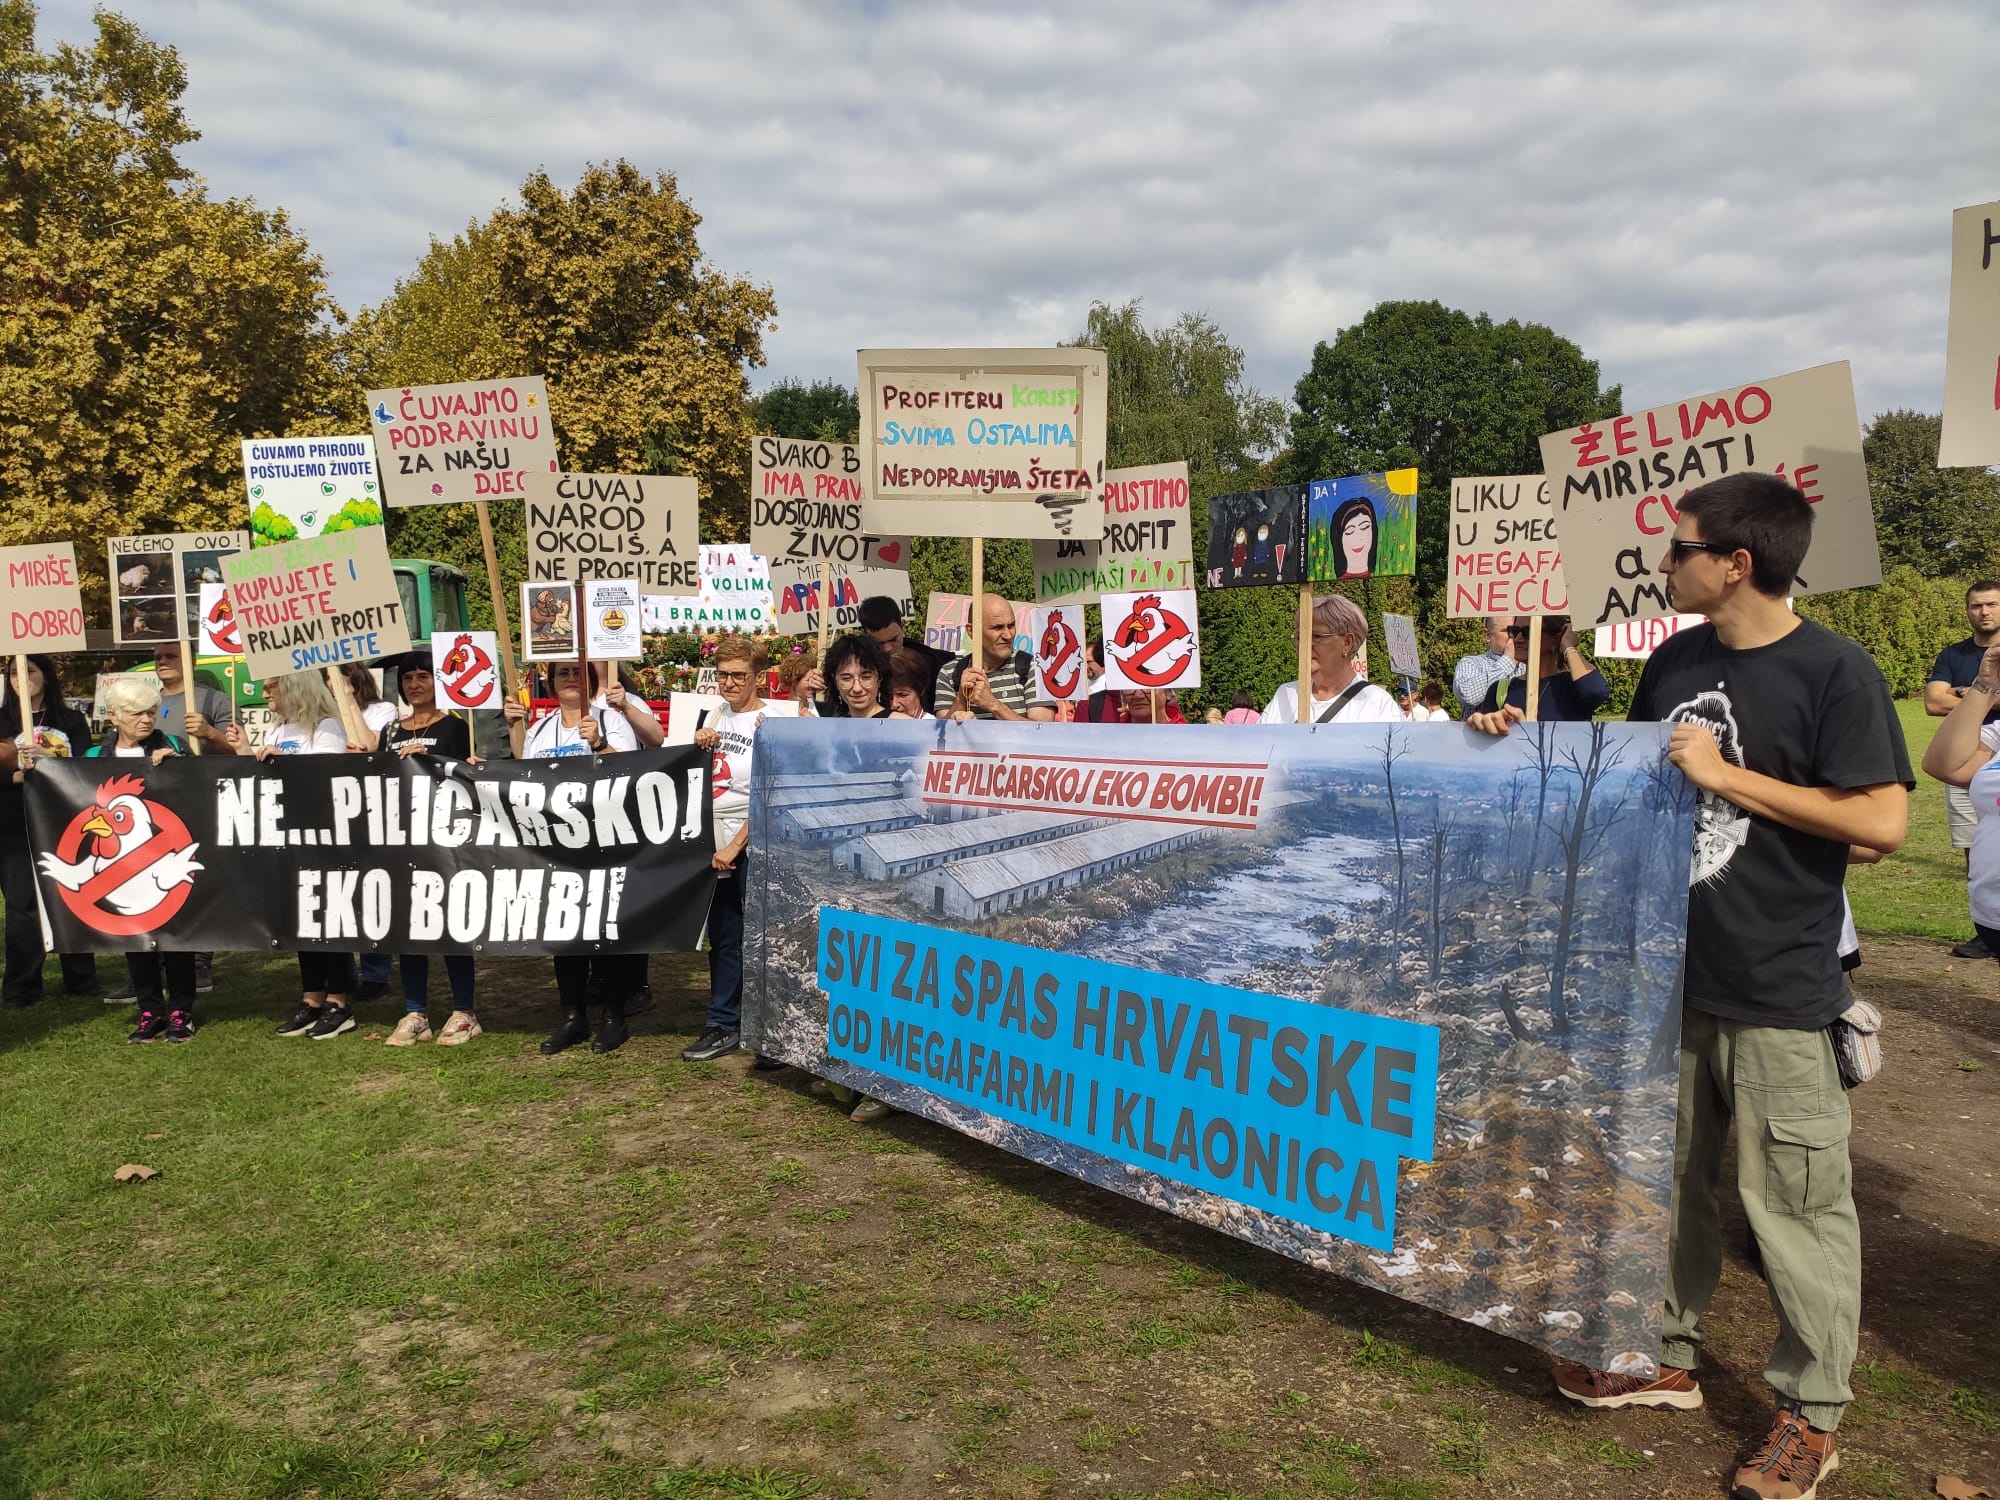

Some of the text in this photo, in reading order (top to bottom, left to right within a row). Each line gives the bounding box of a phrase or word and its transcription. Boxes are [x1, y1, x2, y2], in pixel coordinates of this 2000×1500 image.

[400, 388, 518, 421] ČUVAJMO
[883, 385, 1002, 410] PROFITERU
[389, 416, 539, 449] PODRAVINU
[883, 418, 1074, 447] SVIMA OSTALIMA
[1571, 386, 1772, 468] ŽELIMO
[252, 443, 365, 460] ČUVAMO PRIRODU
[399, 441, 510, 474] ZA NAŠU
[759, 438, 860, 472] SVAKO B
[251, 460, 372, 479] POŠTUJEMO ŽIVOTE
[474, 471, 526, 495] DJEC
[1563, 433, 1754, 511] MIRISATI
[557, 475, 644, 503] ČUVAJ
[764, 472, 861, 501] IMA PRAV
[1104, 478, 1189, 514] PUSTIMO
[1456, 481, 1549, 513] LIKU G
[531, 503, 671, 532] NAROD I
[754, 498, 862, 531] DOSTOJANS
[112, 537, 174, 553] NEĆEMO
[659, 538, 676, 556] A
[787, 527, 880, 561] ŽIVOT
[1099, 520, 1176, 556] PROFIT
[1456, 522, 1477, 546] U
[9, 554, 74, 588] MIRIŠE
[233, 559, 357, 606] KUPUJETE I
[535, 558, 565, 580] NE
[579, 558, 697, 587] PROFITERE
[1041, 557, 1191, 597] NADMAŠI ŽIVOT
[1207, 568, 1224, 588] NE
[238, 591, 337, 628] TRUJETE
[781, 577, 859, 614] APAJA
[11, 607, 82, 639] DOBRO
[247, 603, 399, 654] PRLJAVI PROFIT
[654, 607, 761, 620] I BRANIMO
[291, 632, 381, 670] SNUJETE
[924, 755, 1264, 817] NE PILIĆARSKOJ EKO BOMBI!
[298, 866, 627, 942] EKO BOMBI!
[825, 926, 1417, 1139] SVI ZA SPAS HRVATSKE
[833, 1004, 1386, 1232] OD MEGAFARMI I KLAONICA
